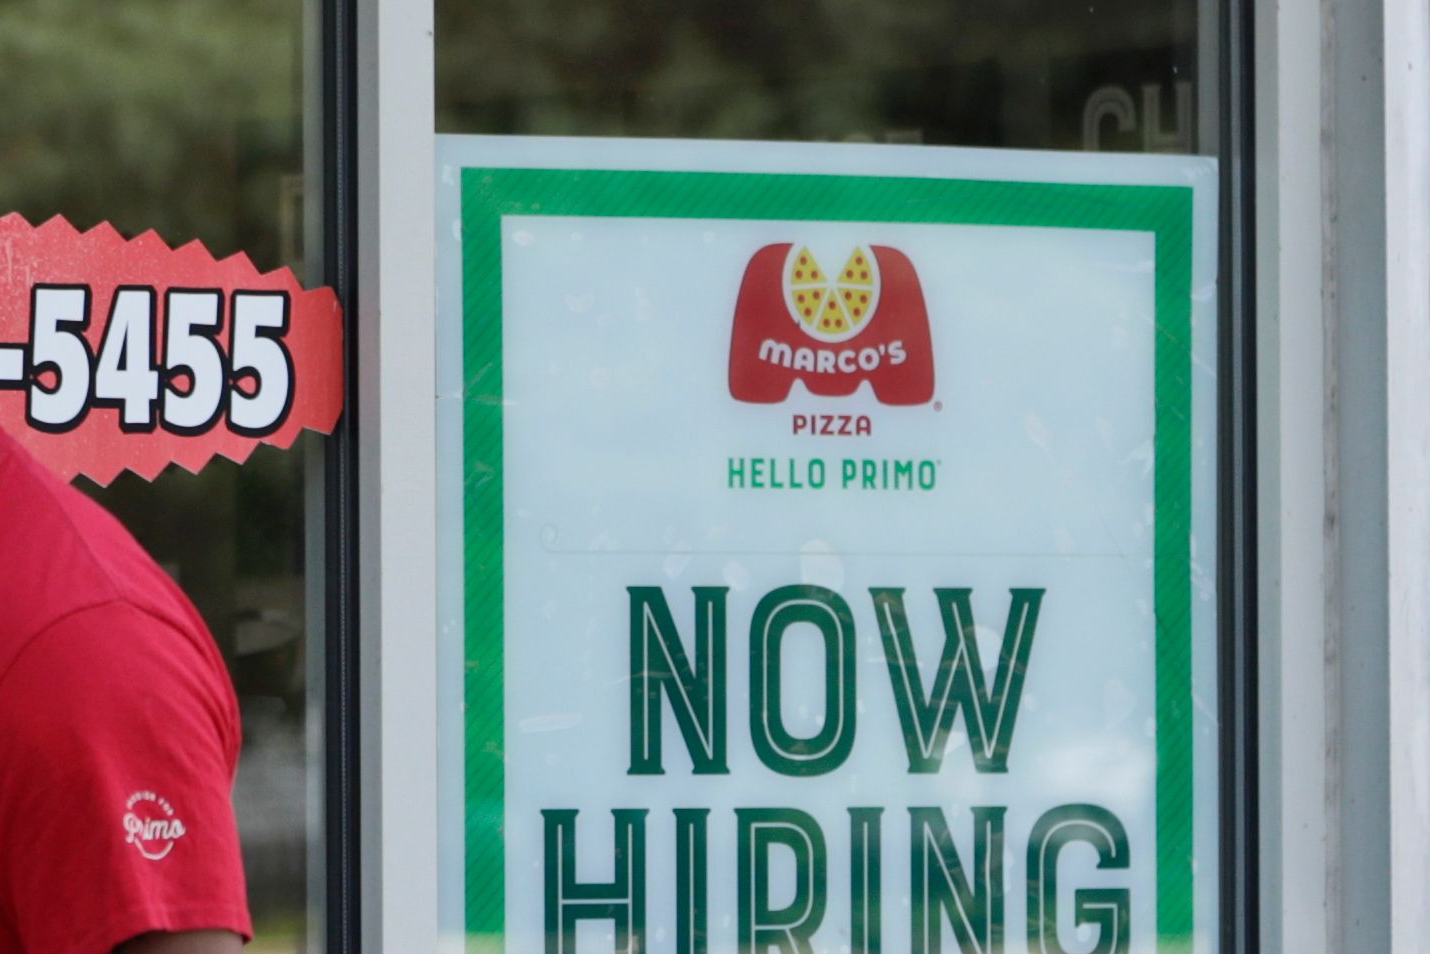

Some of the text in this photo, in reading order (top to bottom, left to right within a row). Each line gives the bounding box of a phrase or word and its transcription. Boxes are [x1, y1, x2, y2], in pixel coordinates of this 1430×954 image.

[758, 338, 908, 374] MARCO'S
[793, 414, 872, 436] PIZZA
[727, 457, 937, 491] HELLO PRIMO
[625, 584, 1047, 777] NOW
